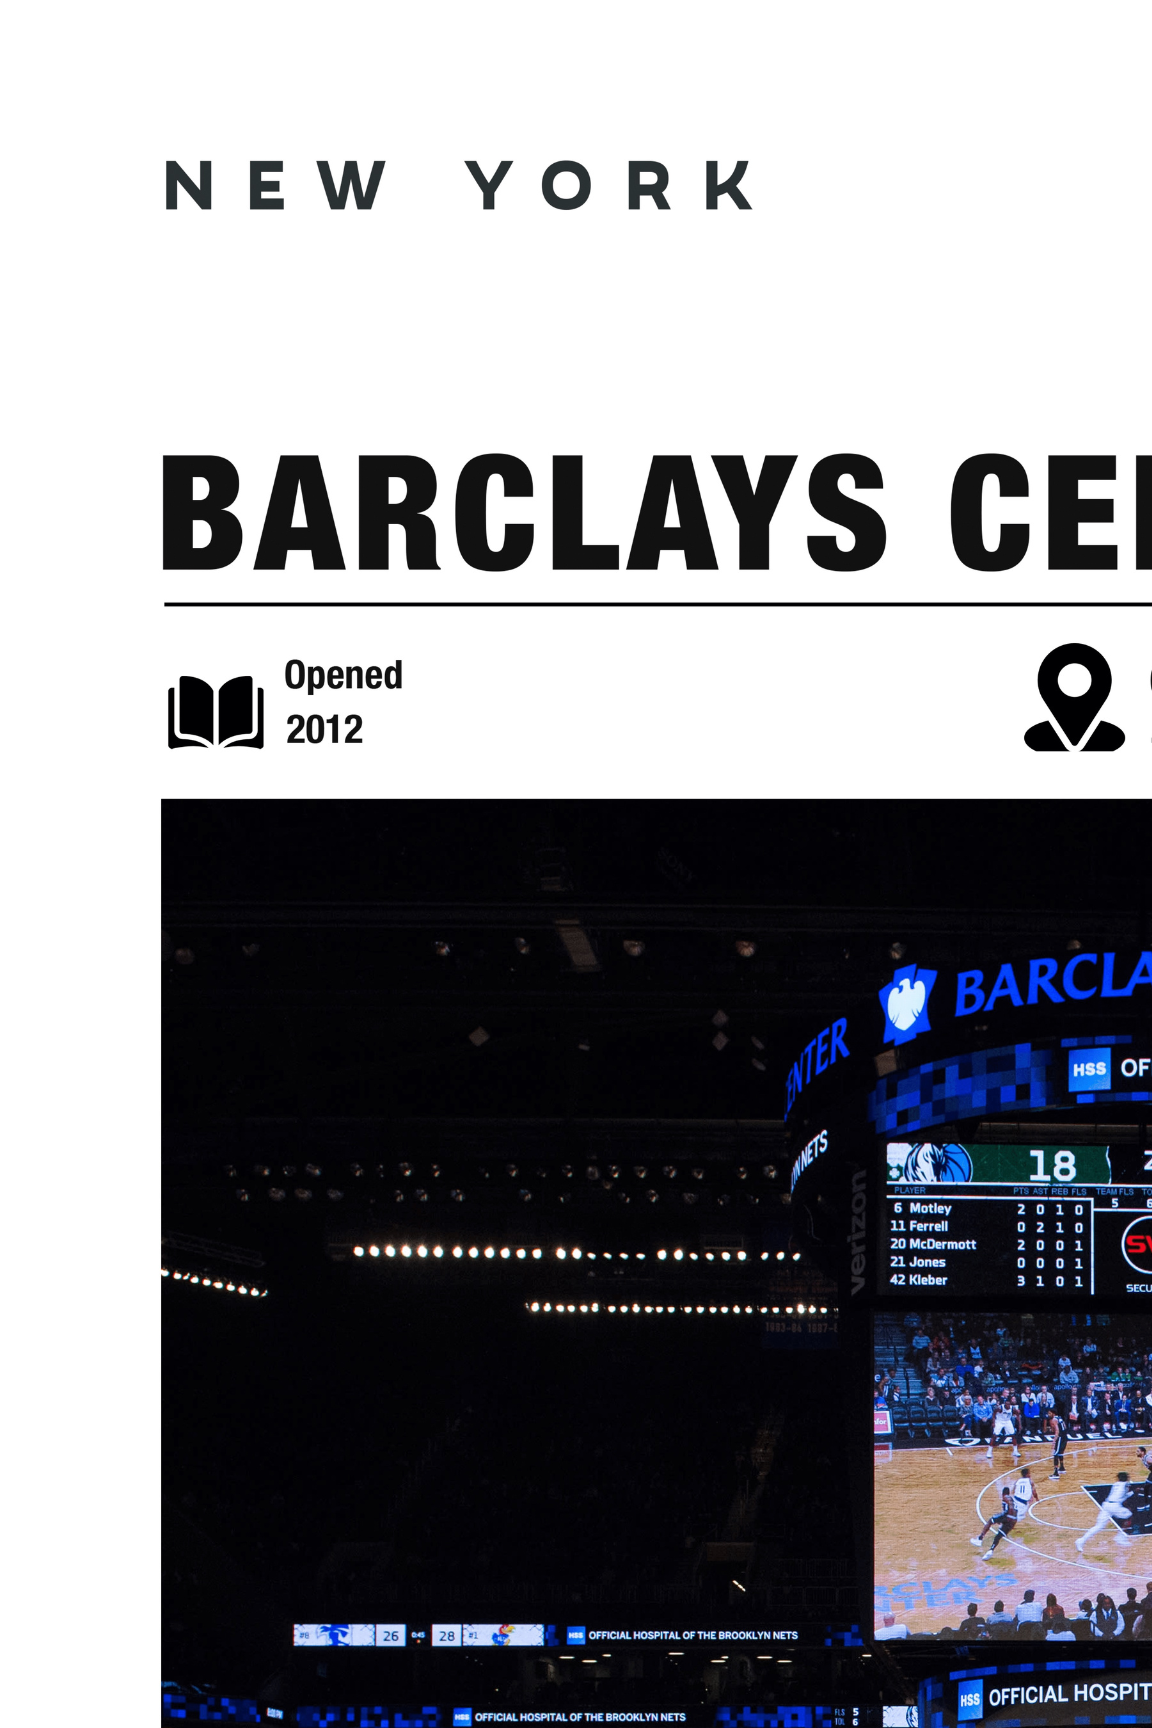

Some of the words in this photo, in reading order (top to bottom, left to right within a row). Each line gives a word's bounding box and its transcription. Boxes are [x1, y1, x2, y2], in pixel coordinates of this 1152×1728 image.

[784, 1017, 850, 1122] ENTER
[1073, 1062, 1107, 1077] HSS
[800, 1129, 828, 1172] NETS
[1030, 1150, 1077, 1182] 18
[894, 1186, 926, 1195] PLAYER
[894, 1203, 902, 1214] 6
[910, 1203, 952, 1216] Motley
[890, 1220, 906, 1232] 11
[910, 1220, 948, 1232] Ferrell
[847, 1168, 867, 1297] verizon
[890, 1238, 906, 1250] 20
[910, 1238, 977, 1250] McDermott
[890, 1256, 906, 1268] 21
[909, 1256, 946, 1268] Jones
[890, 1274, 906, 1286] 42
[909, 1274, 948, 1286] Kleber
[383, 1631, 399, 1642] 26
[440, 1631, 455, 1642] 28
[588, 1630, 632, 1640] OFFICIAL
[633, 1630, 681, 1640] HOSPITAL
[683, 1630, 695, 1640] OF
[697, 1630, 717, 1640] THE
[718, 1630, 771, 1640] BROOKLYN
[772, 1630, 799, 1640] NETS
[960, 1693, 980, 1708] HSS
[989, 1685, 1069, 1707] OFFICIAL
[474, 1712, 518, 1722] OFFICIAL
[519, 1712, 568, 1722] HOSPITAL
[569, 1712, 582, 1722] OF
[584, 1712, 604, 1722] THE
[605, 1712, 659, 1722] BROOKLYN
[660, 1712, 687, 1722] NETS
